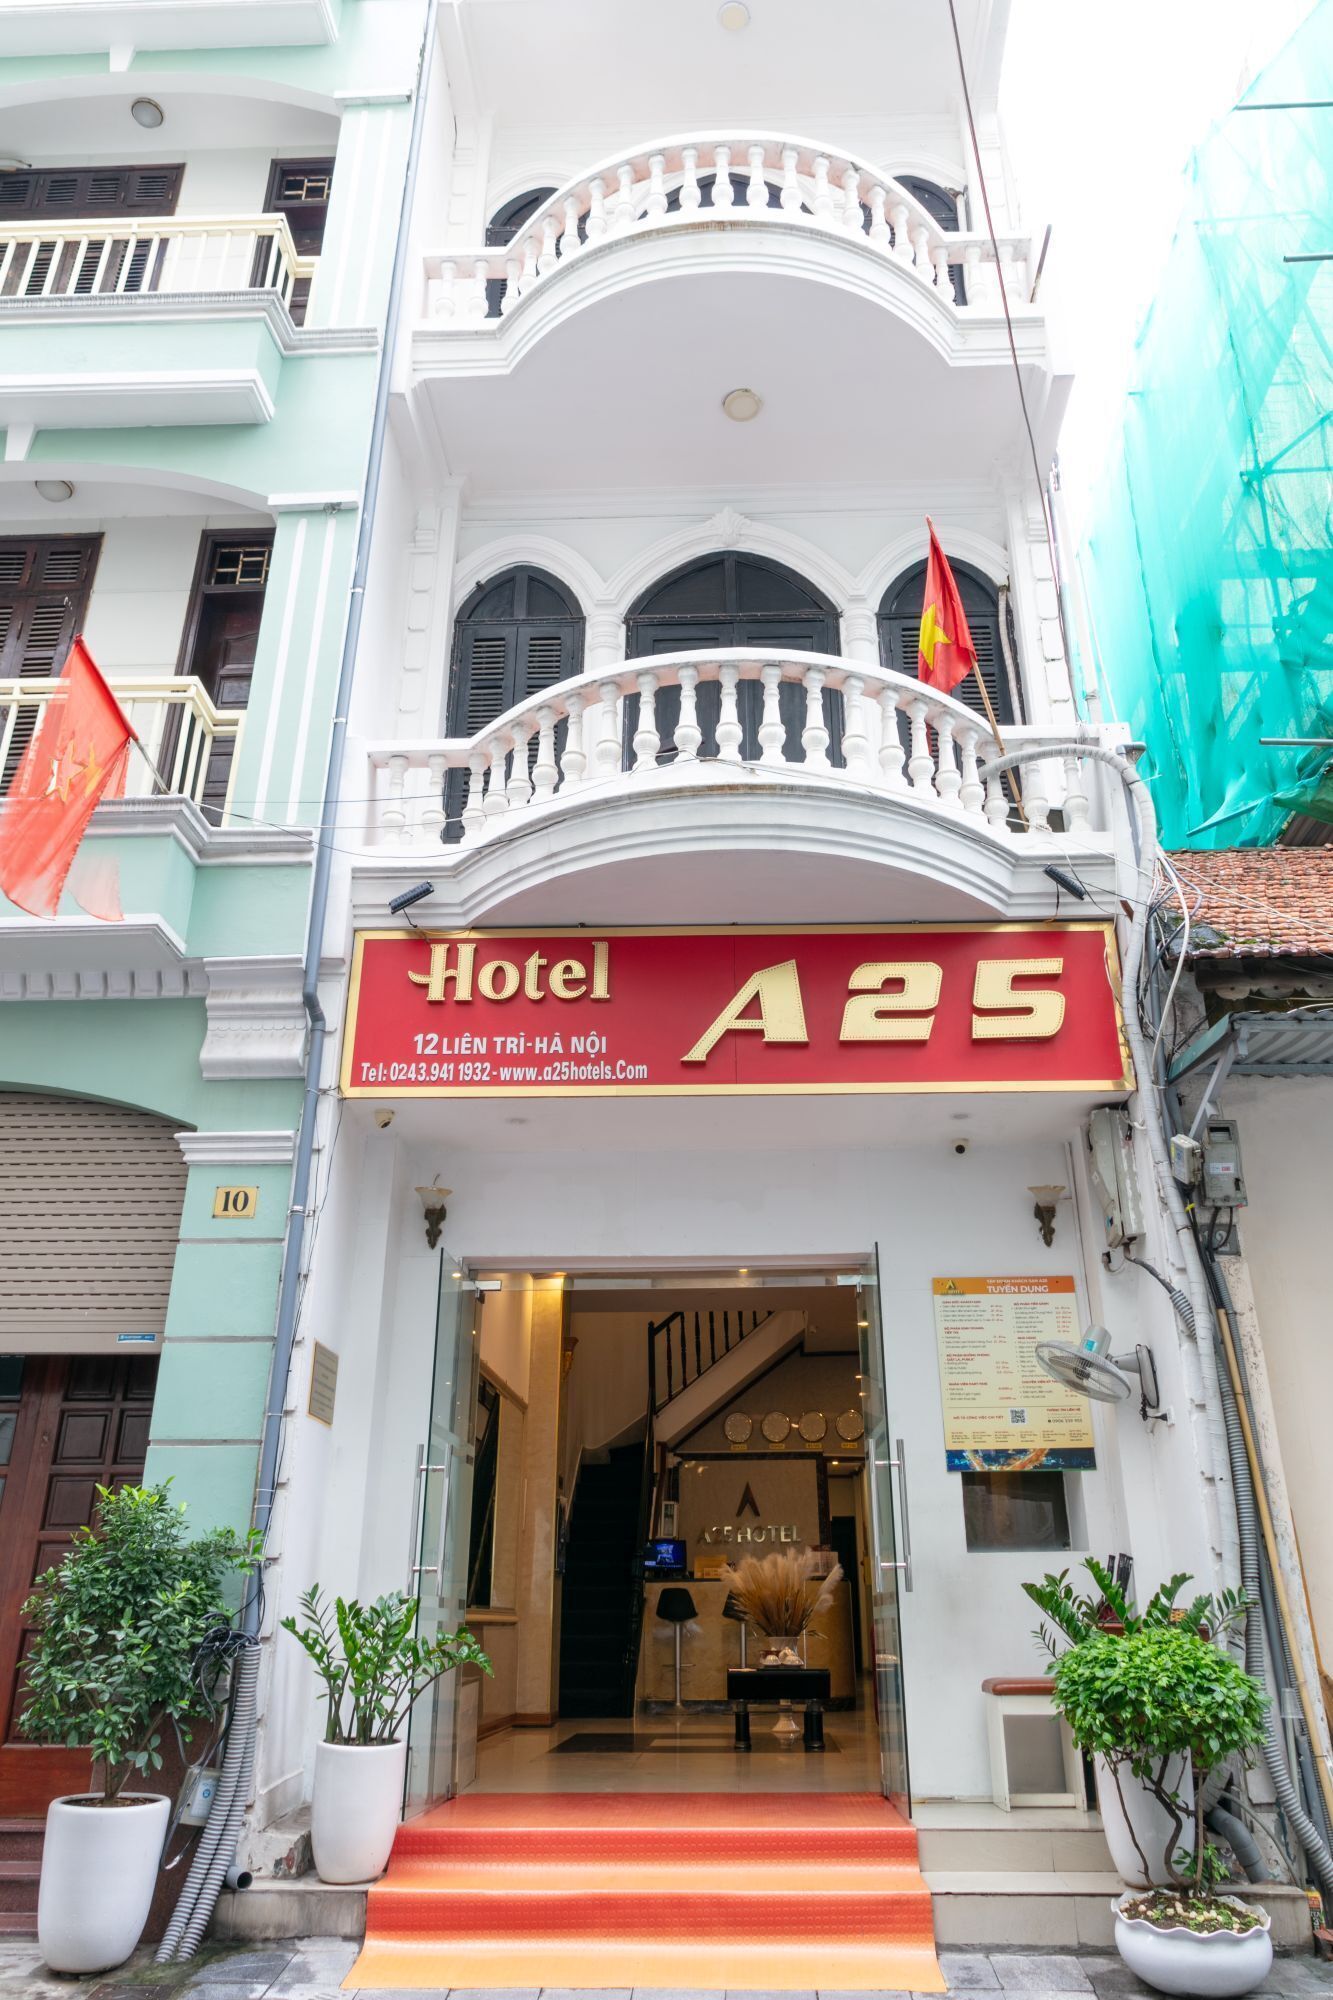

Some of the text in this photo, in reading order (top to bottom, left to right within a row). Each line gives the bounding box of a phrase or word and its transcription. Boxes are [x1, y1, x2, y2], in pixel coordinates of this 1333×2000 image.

[408, 941, 611, 1001] Hotel
[680, 958, 1066, 1062] A25
[413, 1033, 439, 1055] 12
[442, 1032, 487, 1055] LIÊN
[571, 1031, 607, 1058] NỘI
[222, 1190, 249, 1212] 10
[737, 1525, 801, 1543] HOTEL
